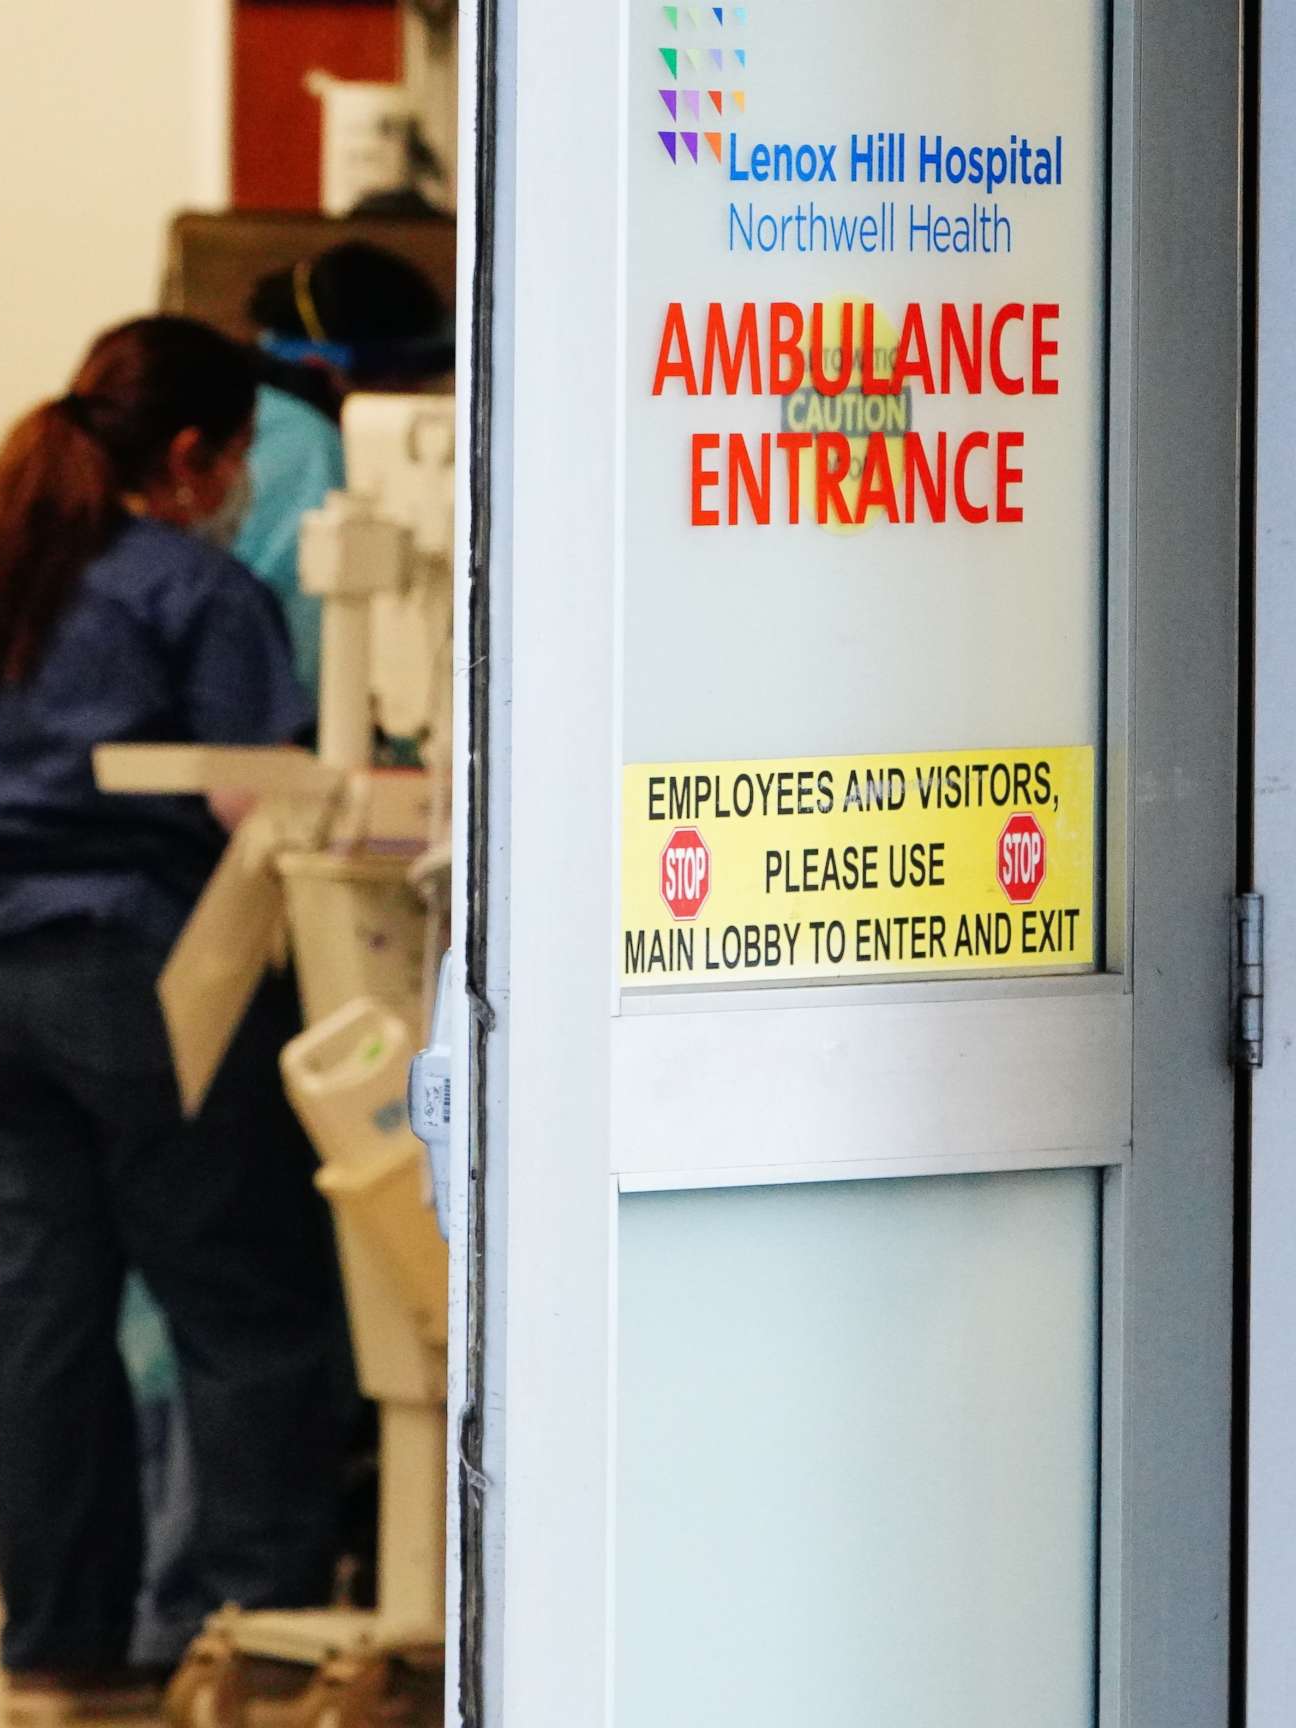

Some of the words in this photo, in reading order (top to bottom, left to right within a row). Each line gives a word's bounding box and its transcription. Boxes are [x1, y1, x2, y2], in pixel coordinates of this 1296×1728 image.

[729, 132, 838, 182] Lenox
[850, 132, 905, 183] Hill
[919, 134, 1062, 194] Hospital
[729, 201, 895, 253] Northwell
[909, 202, 1011, 253] Health
[652, 302, 1060, 397] AMBULANCE
[787, 392, 906, 434] CAUTION
[691, 431, 1025, 527] ENTRANCE
[648, 769, 834, 821] EMPLOYEES
[842, 767, 906, 813] AND
[916, 761, 1059, 813] VISITORS,
[665, 846, 706, 901] STOP
[765, 845, 879, 894] PLEASE
[889, 842, 945, 888] USE
[1002, 831, 1042, 885] STOP
[625, 927, 694, 974] MAIN
[705, 922, 801, 970] LOBBY
[809, 920, 846, 965] TO
[856, 914, 947, 962] ENTER
[954, 911, 1012, 957] AND
[1021, 908, 1080, 954] EXIT
